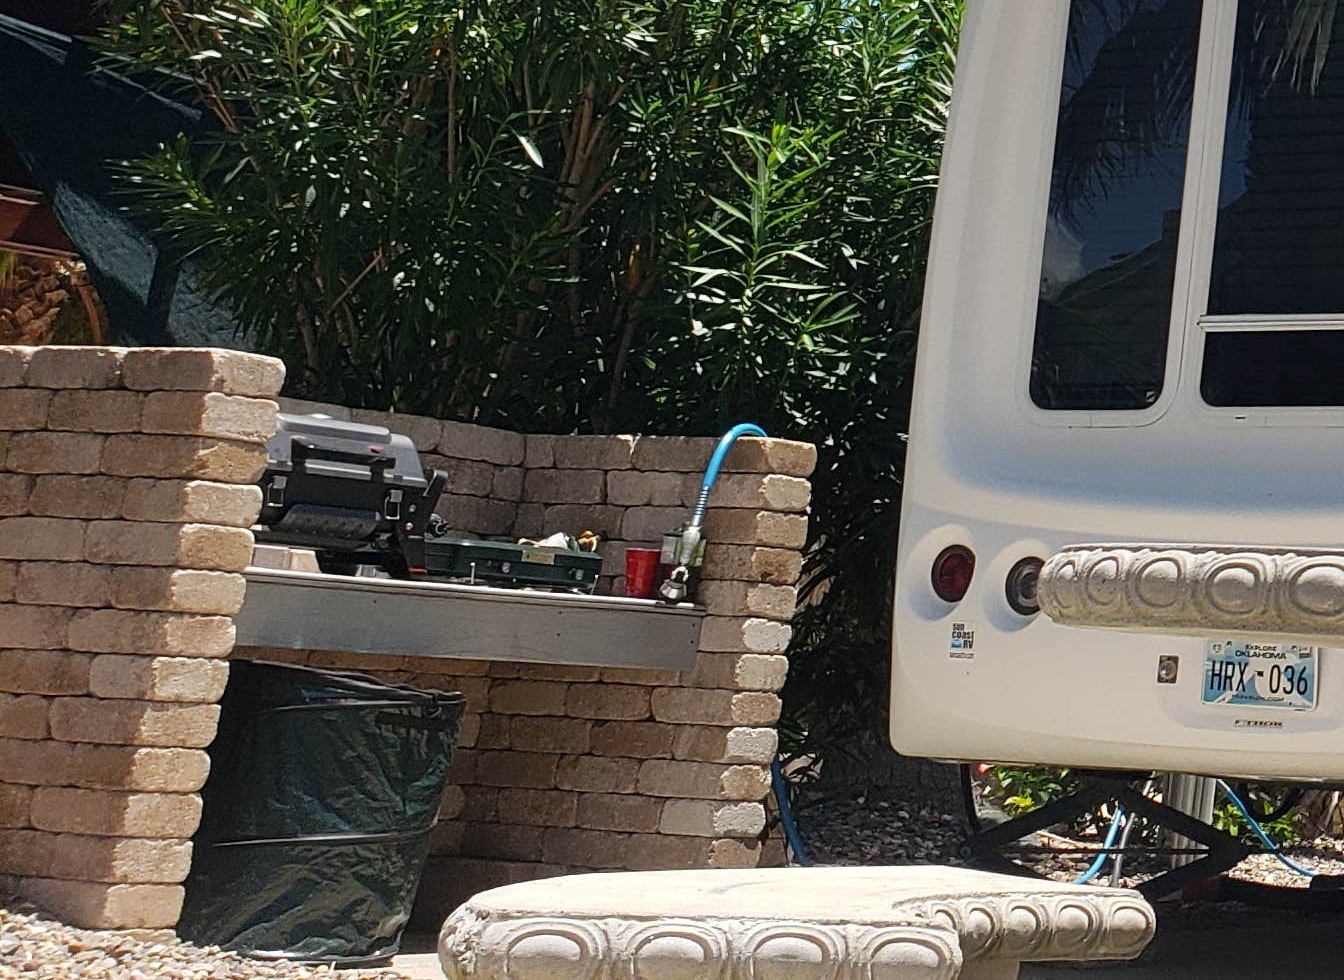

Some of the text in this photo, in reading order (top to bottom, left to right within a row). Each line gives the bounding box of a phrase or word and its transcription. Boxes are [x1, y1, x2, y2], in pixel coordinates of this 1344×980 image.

[1235, 650, 1287, 660] OKLAHOMA
[1210, 660, 1308, 696] HRX 036
